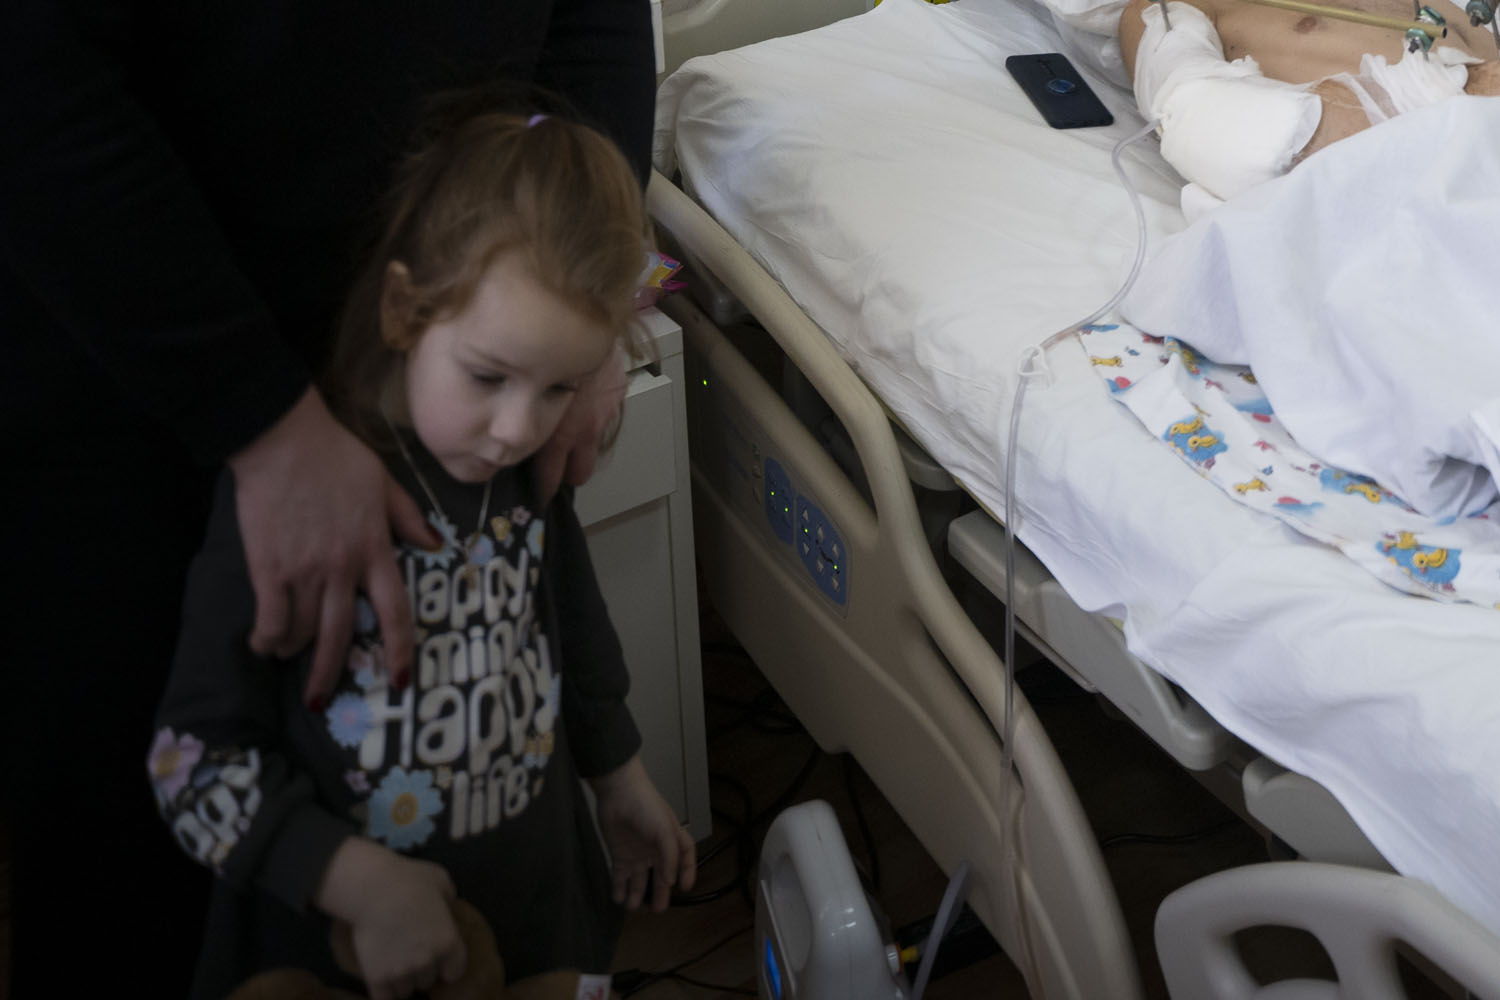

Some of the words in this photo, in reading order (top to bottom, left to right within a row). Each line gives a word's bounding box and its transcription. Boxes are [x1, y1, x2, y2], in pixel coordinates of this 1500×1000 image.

[418, 600, 530, 690] min
[359, 634, 554, 775] Happy
[451, 756, 529, 839] life
